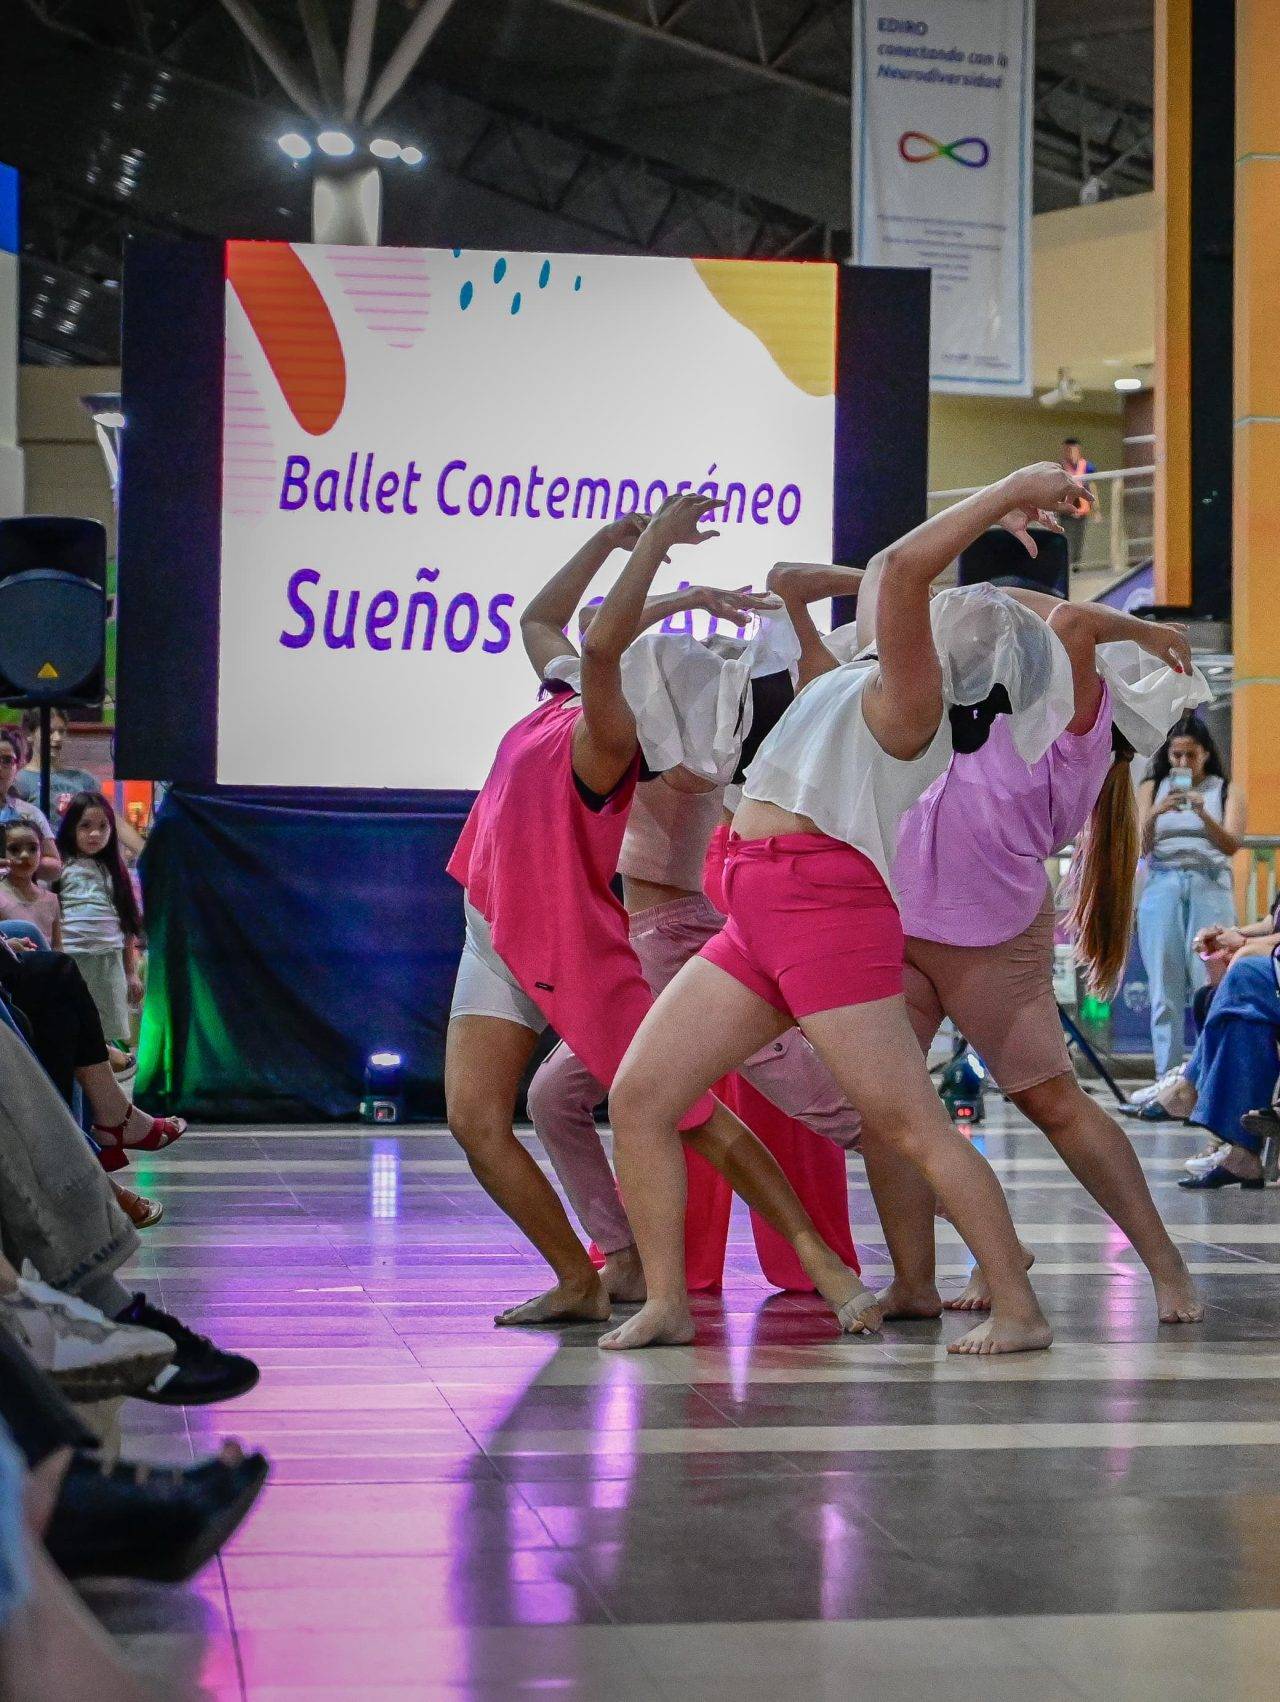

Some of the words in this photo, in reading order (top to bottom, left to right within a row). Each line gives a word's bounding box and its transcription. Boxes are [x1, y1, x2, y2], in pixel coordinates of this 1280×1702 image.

[877, 44, 965, 62] conectando
[968, 52, 994, 65] con
[279, 452, 422, 516] Ballet
[279, 567, 516, 654] Sueños
